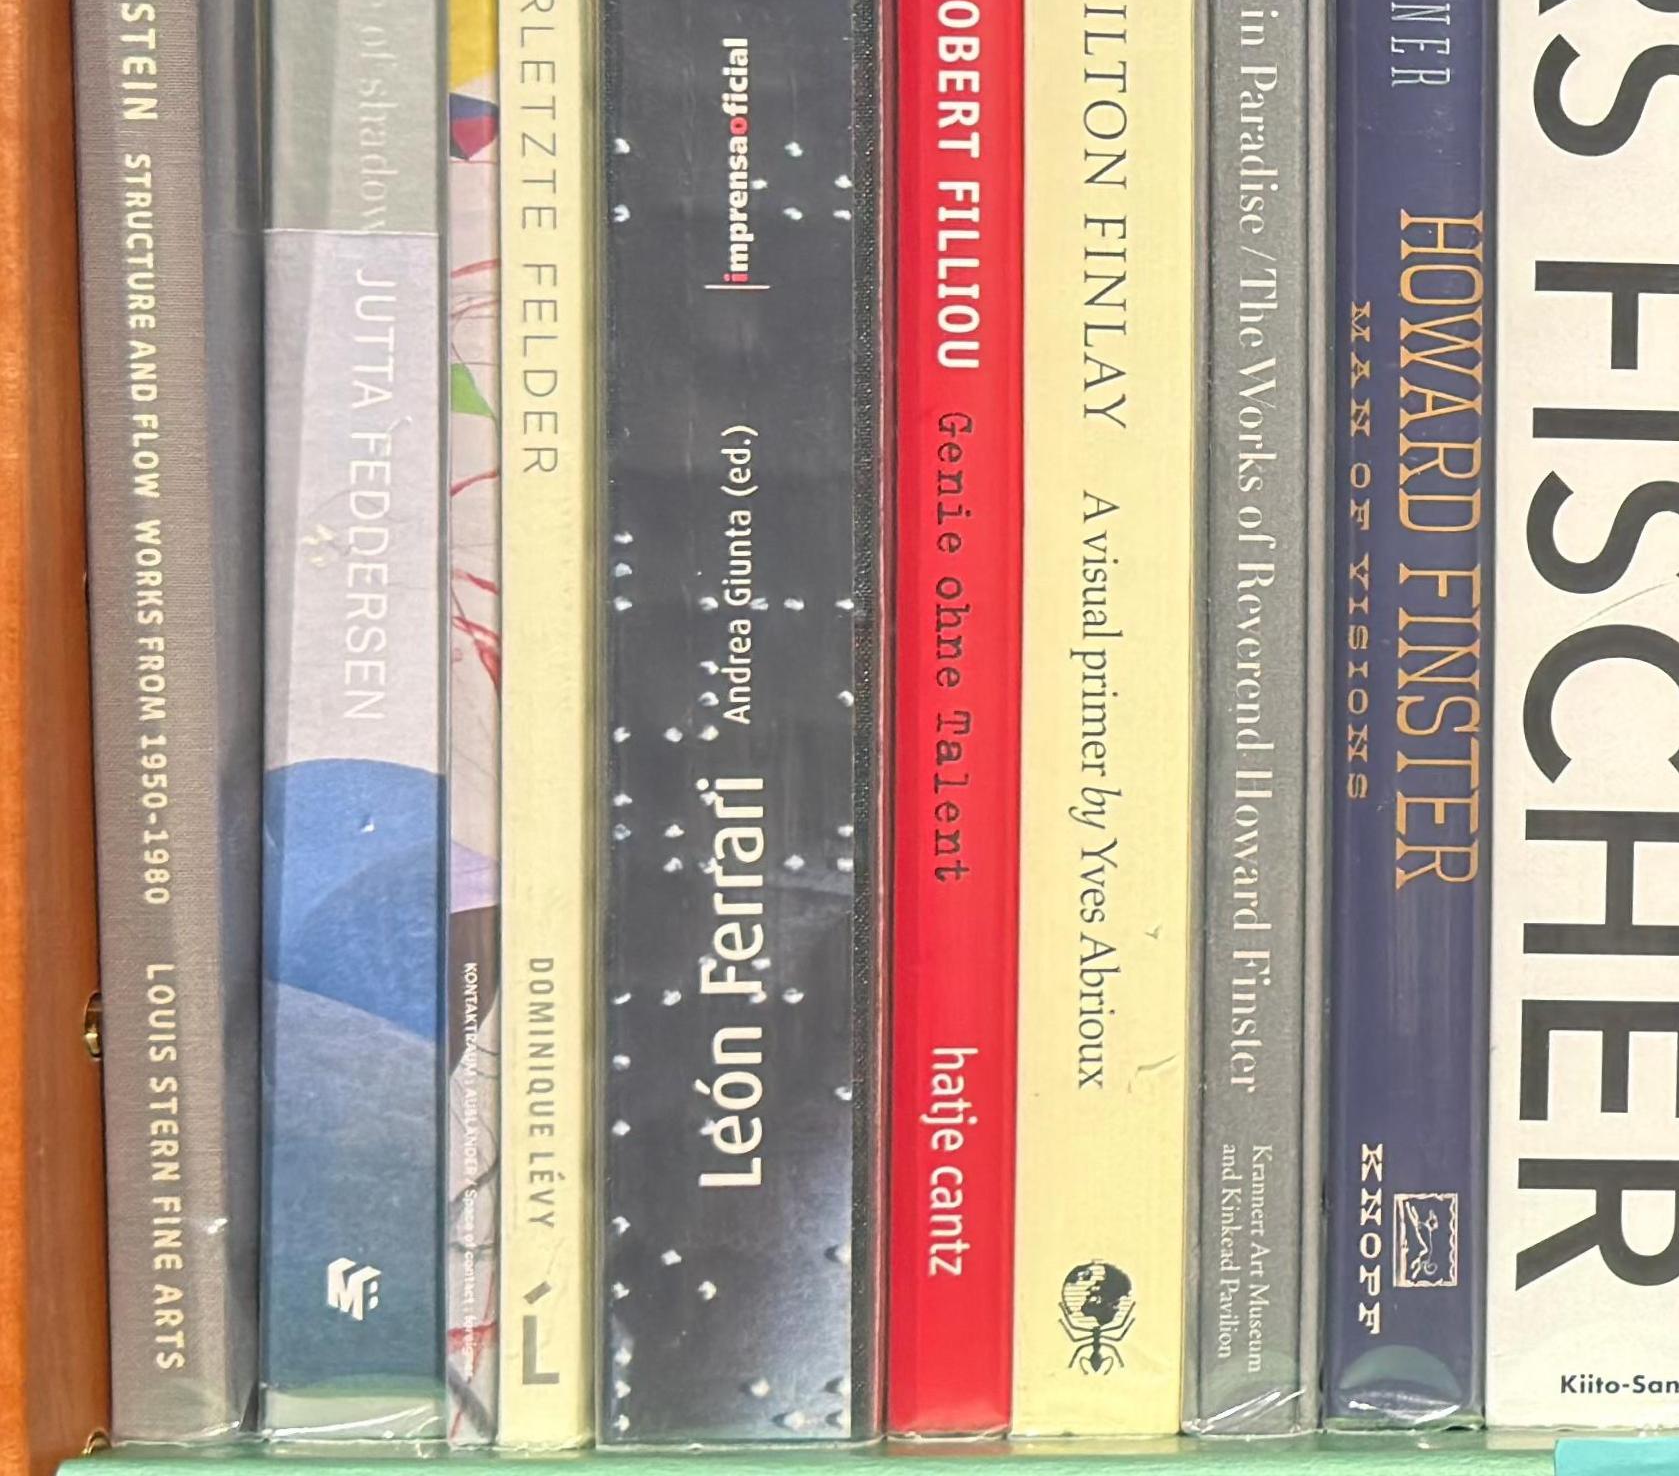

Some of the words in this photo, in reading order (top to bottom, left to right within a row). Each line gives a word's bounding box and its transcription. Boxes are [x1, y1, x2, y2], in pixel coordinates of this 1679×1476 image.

[1240, 67, 1278, 233] Paradise
[125, 154, 155, 328] STRUCTURE
[938, 182, 980, 368] FILLIOU
[352, 269, 396, 408] JUTTA
[1084, 214, 1126, 428] FINLAY
[1240, 269, 1277, 346] The
[130, 341, 157, 401] AND
[522, 264, 558, 472] FELDER
[1350, 301, 1371, 437] MAN
[1399, 209, 1483, 532] HOWARD
[133, 415, 160, 498] FLOW
[721, 426, 758, 496] (ed.)
[1239, 358, 1276, 491] Works
[937, 413, 975, 555] Genie
[1350, 463, 1371, 530] OF
[135, 518, 164, 627] WORKS
[340, 433, 397, 718] FEDDERSEN
[722, 511, 751, 605] Giunta
[1083, 531, 1123, 638] visual
[138, 638, 166, 722] FROM
[721, 620, 751, 724] Andrea
[936, 577, 971, 689] ohne
[1236, 561, 1276, 750] Reverend
[1347, 553, 1370, 799] VISIONS
[1070, 649, 1118, 777] primer
[1396, 563, 1482, 889] FINSTER
[141, 735, 170, 904] 1950-1980
[934, 711, 973, 882] Talent
[1069, 787, 1122, 829] by
[1232, 767, 1274, 931] Howard
[696, 779, 770, 1003] Ferrari
[1080, 838, 1117, 923] Yves
[147, 965, 176, 1061] LOUIS
[526, 958, 554, 1136] DOMINIQUE
[1079, 932, 1121, 1088] Abrioux
[1230, 948, 1273, 1092] Finster
[149, 1077, 180, 1180] STERN
[695, 1025, 764, 1189] León
[921, 1048, 978, 1151] hatje
[528, 1152, 554, 1228] LÉVY
[1221, 1143, 1241, 1179] and
[1251, 1146, 1272, 1236] Krannert
[152, 1197, 182, 1269] FINE
[930, 1166, 969, 1275] cantz
[1221, 1187, 1242, 1272] Kinkead
[1250, 1242, 1270, 1277] Art
[1359, 1144, 1382, 1334] KNOPF
[154, 1284, 185, 1368] ARTS
[1218, 1277, 1240, 1359] Pavilion
[1248, 1284, 1270, 1372] Museum
[1561, 1374, 1679, 1393] Kiito-San
